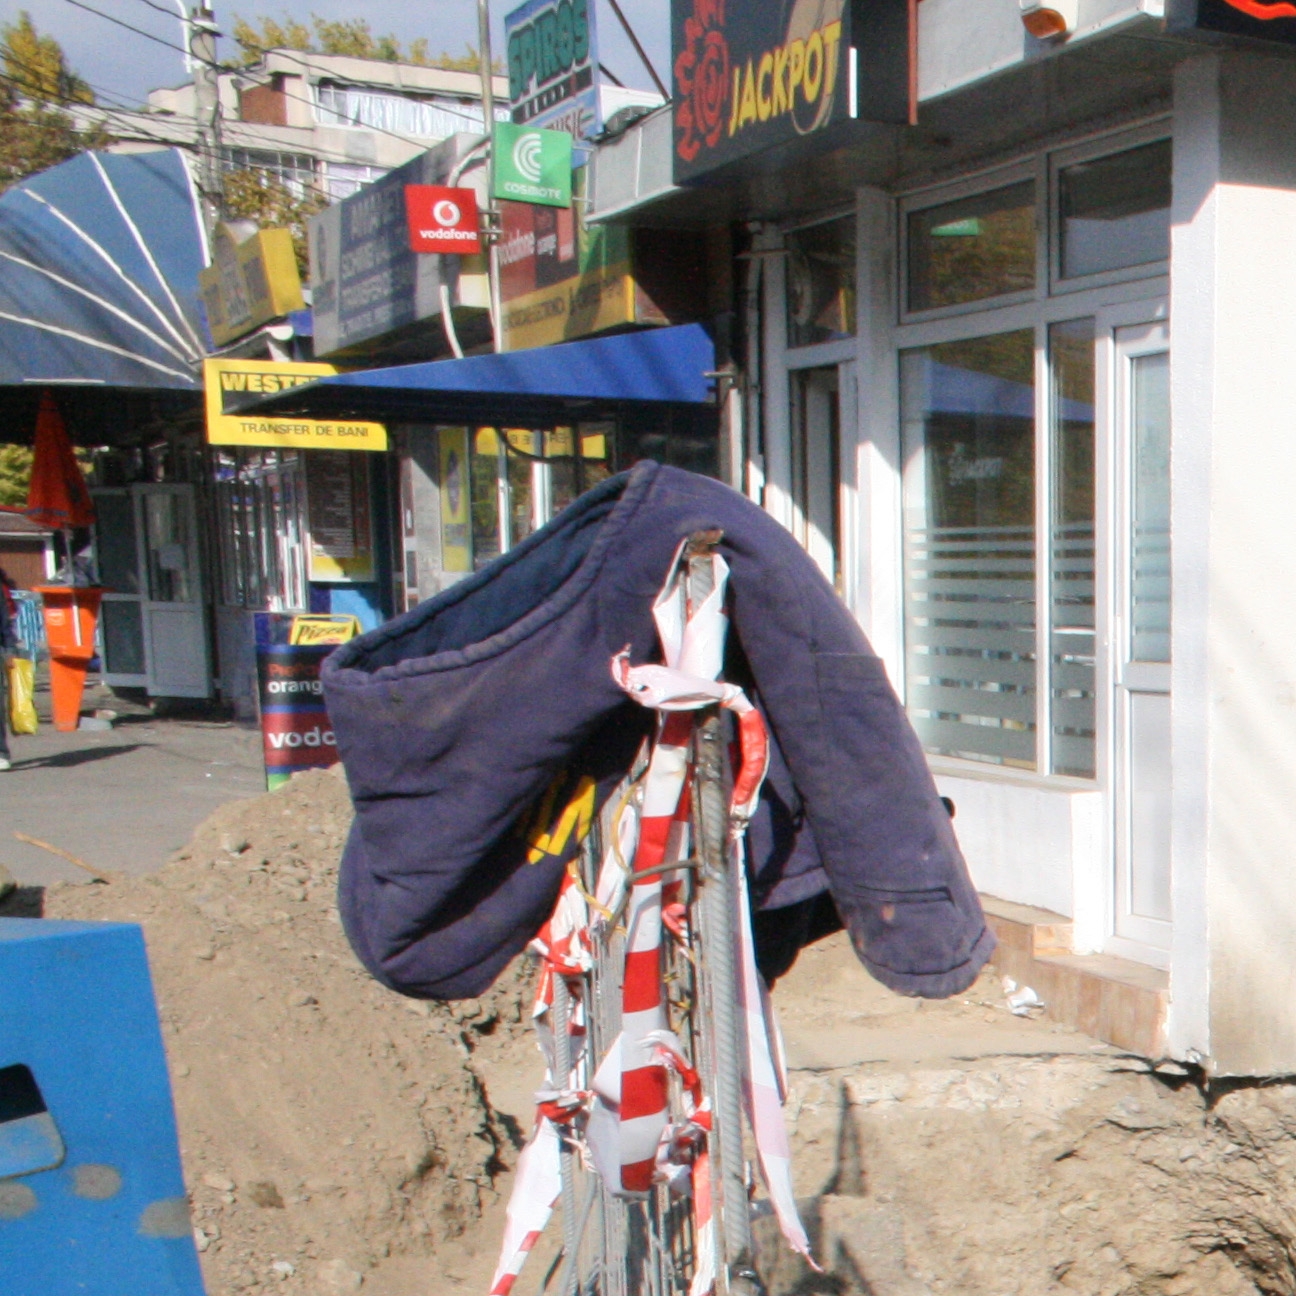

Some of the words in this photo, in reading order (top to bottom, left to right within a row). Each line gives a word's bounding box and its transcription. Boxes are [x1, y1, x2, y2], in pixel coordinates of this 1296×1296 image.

[507, 0, 588, 103] SPIROS
[728, 20, 841, 137] JACKPOT
[504, 182, 562, 200] COSMOTE
[420, 229, 477, 240] vodafone
[221, 373, 322, 394] WESTE
[240, 422, 310, 435] TRANSFER
[316, 426, 333, 436] DE
[338, 426, 369, 437] BANI
[268, 680, 323, 695] orang
[268, 726, 338, 749] voda
